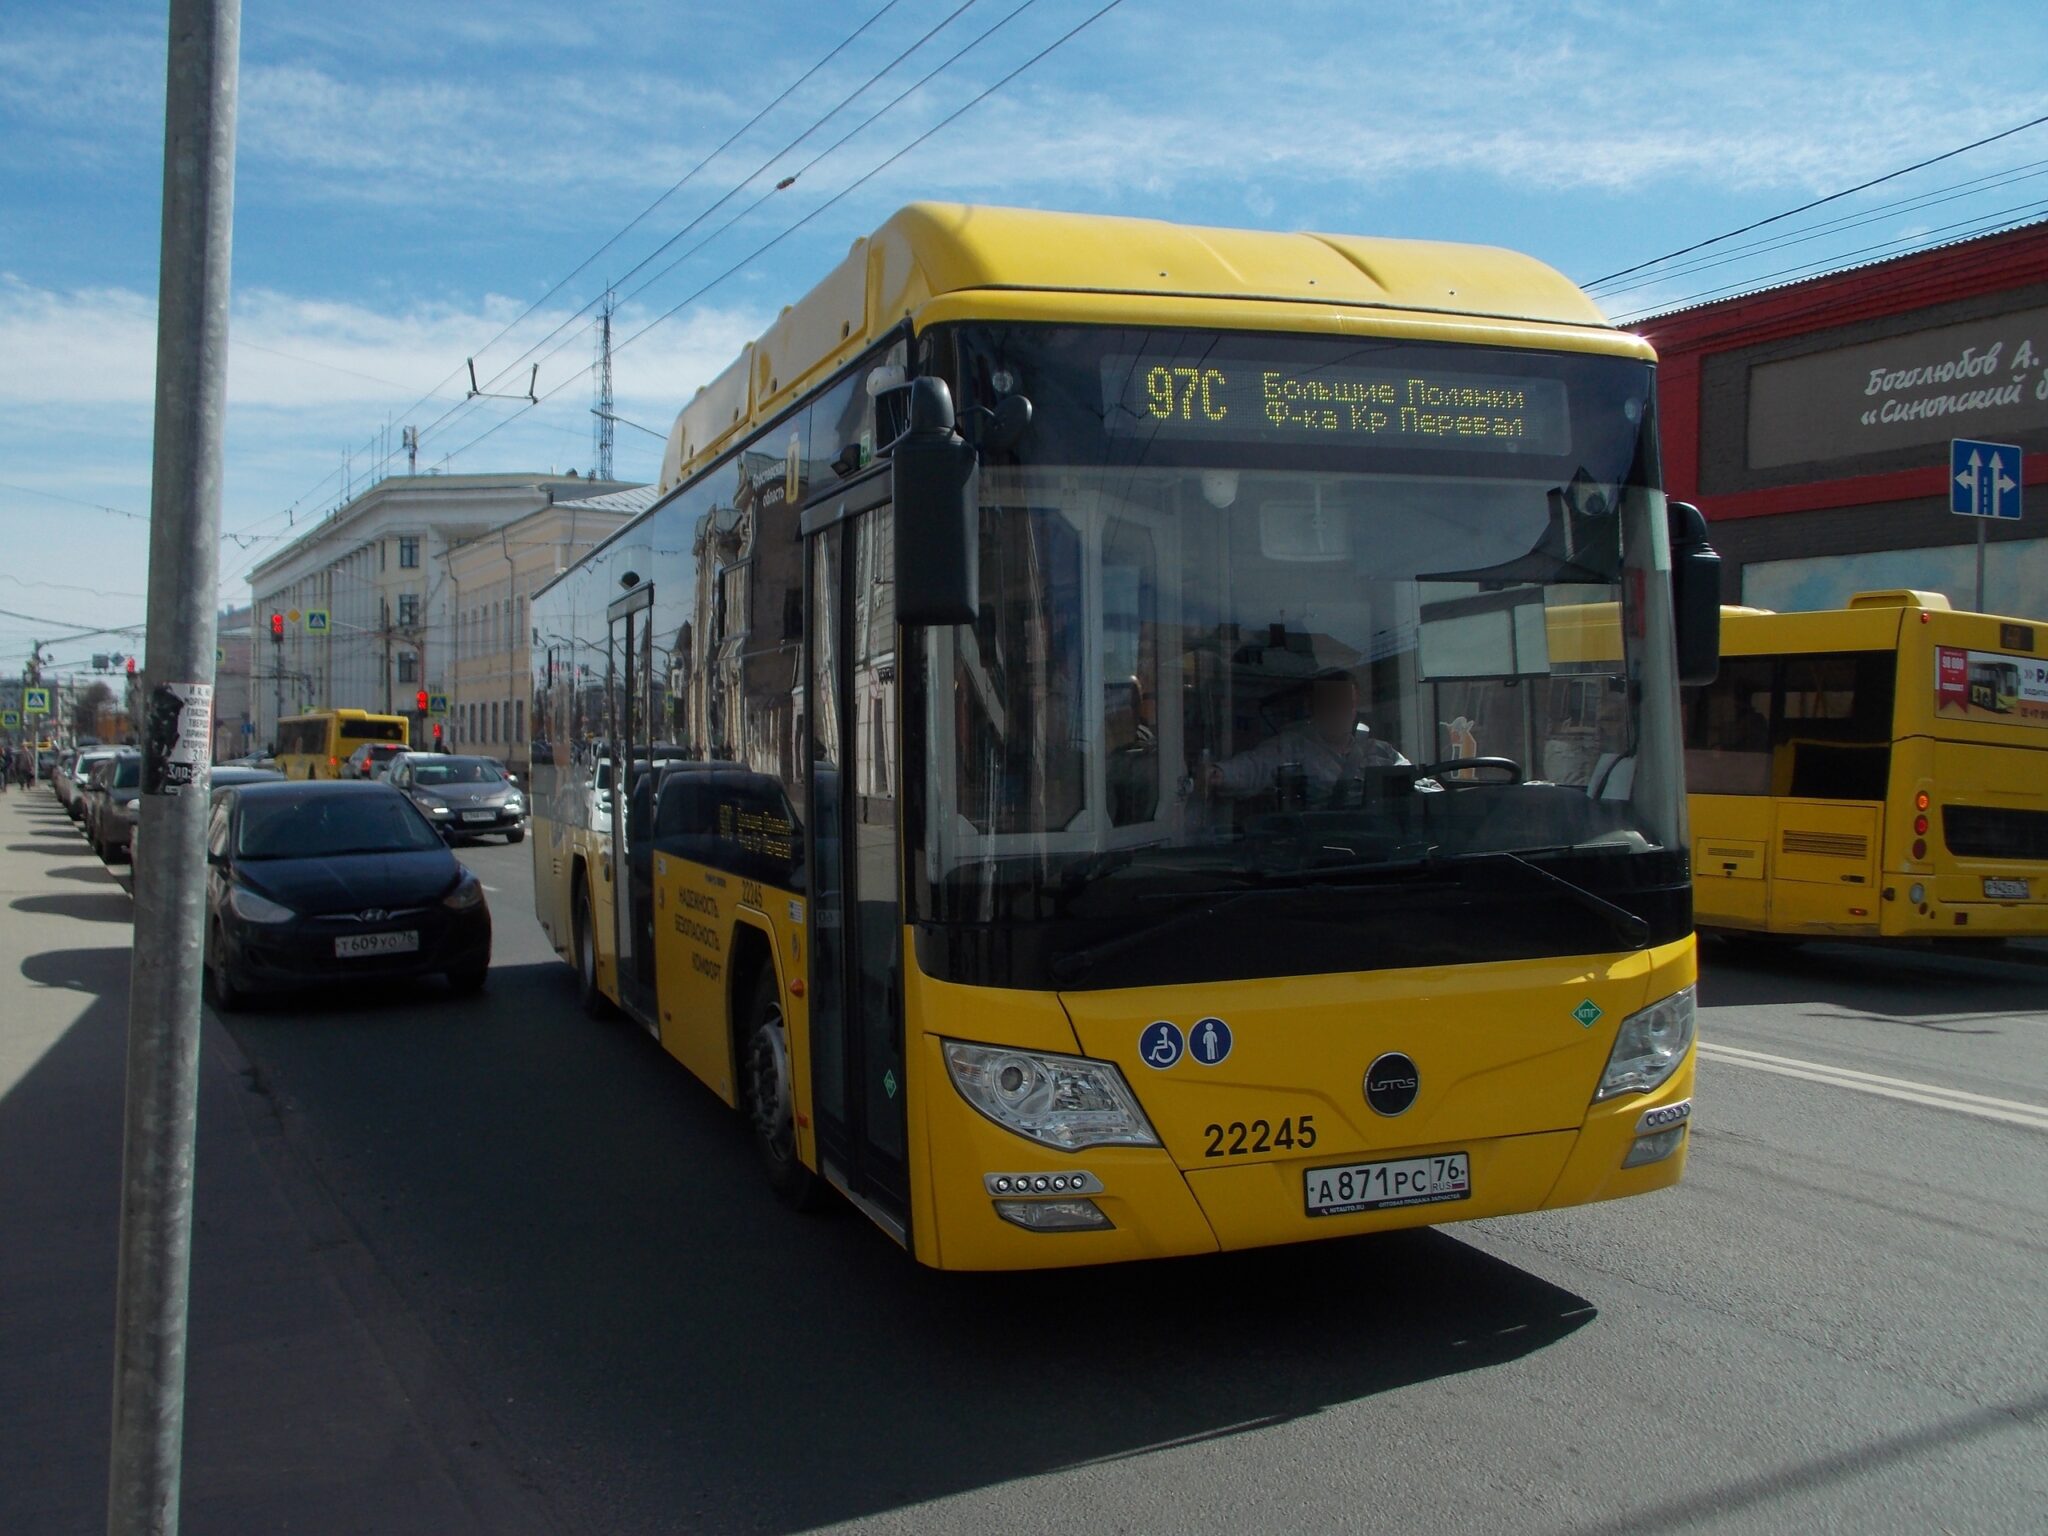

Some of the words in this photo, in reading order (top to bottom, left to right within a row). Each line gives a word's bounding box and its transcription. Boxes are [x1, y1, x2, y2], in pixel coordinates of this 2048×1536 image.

[1864, 341, 2003, 396] Боголюбов
[1263, 371, 1395, 404] Большие
[1408, 379, 1526, 409] Полянки
[1264, 400, 1338, 430] Ф-ка
[1351, 404, 1387, 434] Кр
[1400, 406, 1523, 436] Перевал
[1204, 1115, 1318, 1158] 22245
[1432, 1180, 1452, 1191] RUS
[1433, 1158, 1459, 1182] 76
